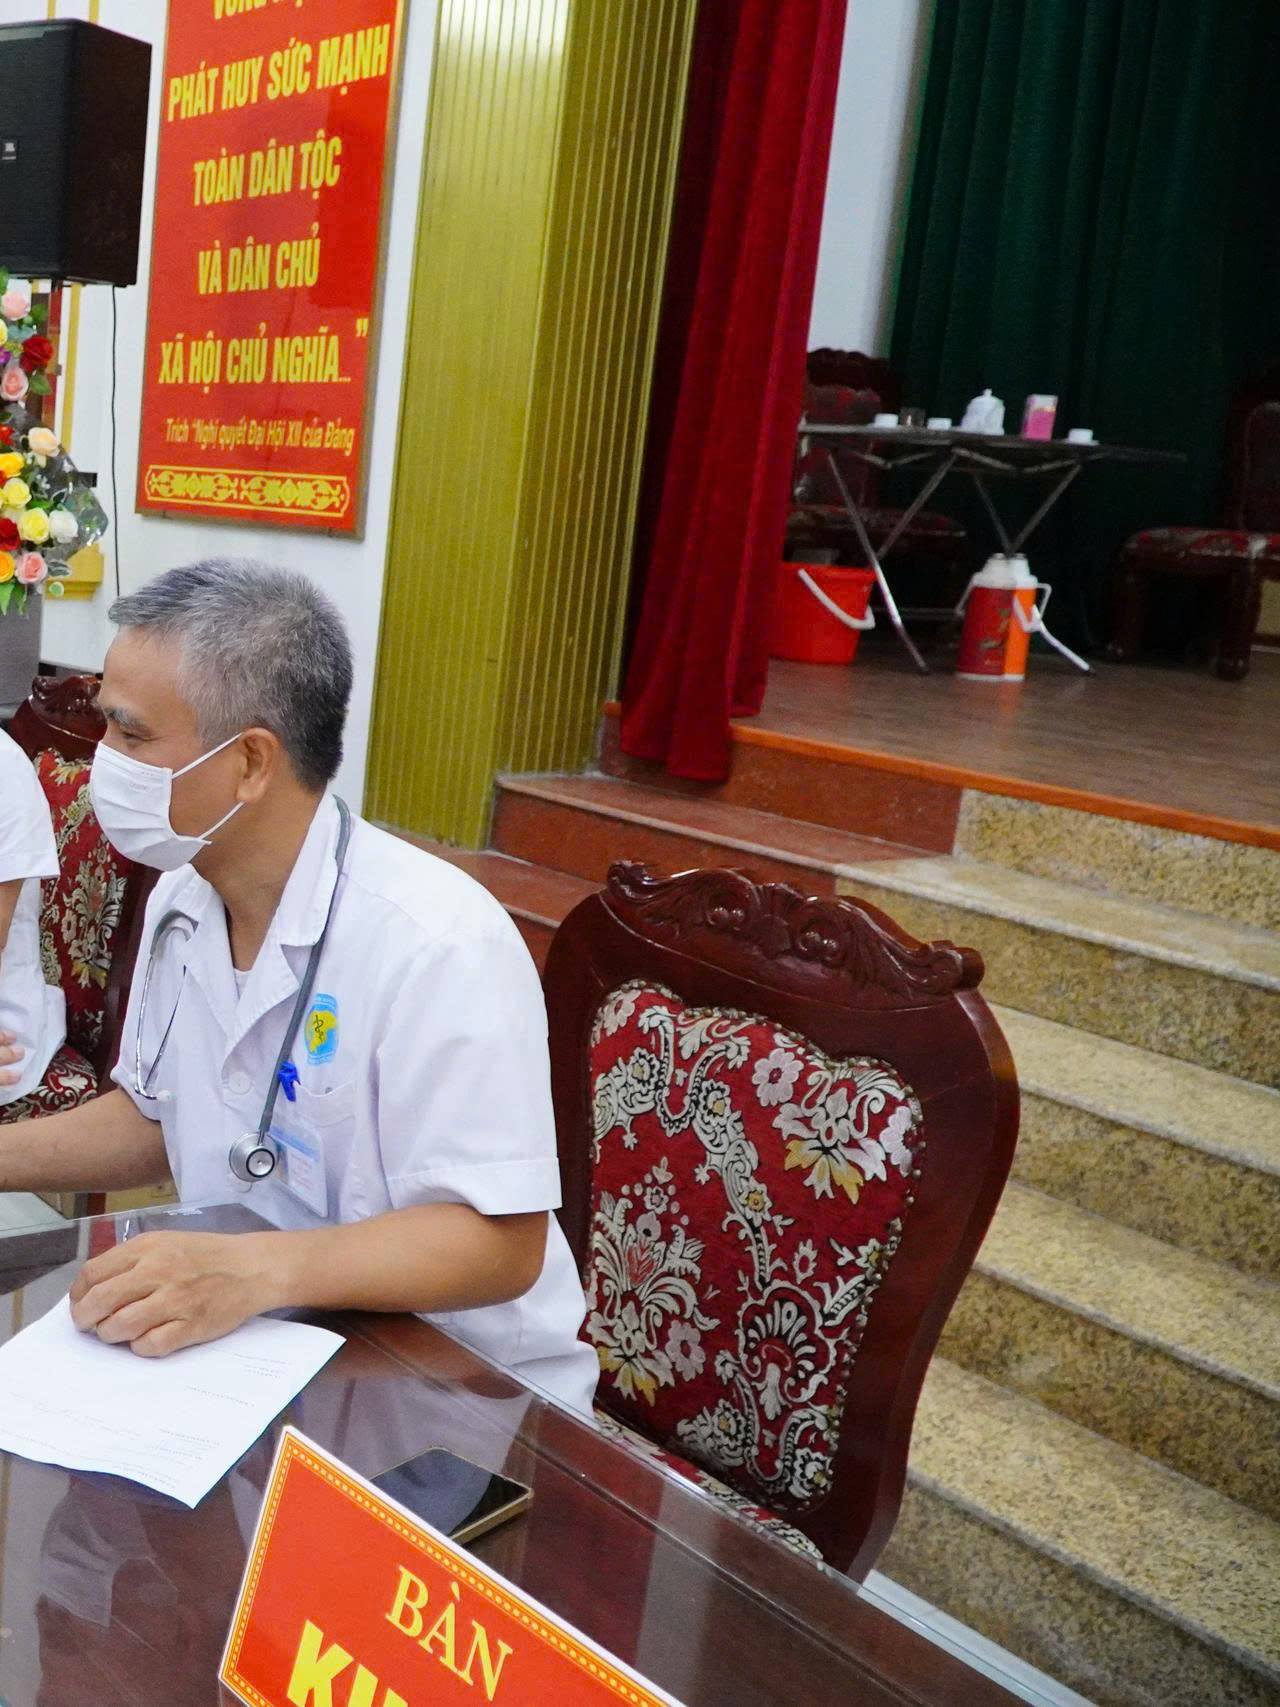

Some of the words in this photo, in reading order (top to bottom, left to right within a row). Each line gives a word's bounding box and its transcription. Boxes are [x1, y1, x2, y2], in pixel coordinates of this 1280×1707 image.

[168, 60, 218, 122] PHÁT
[222, 56, 264, 111] HUY
[267, 37, 312, 100] SỨC
[316, 24, 390, 96] MẠNH
[193, 148, 245, 207] TOÀN
[248, 138, 294, 198] DÂN
[300, 128, 342, 200] TỘC
[198, 240, 222, 295] VÀ
[227, 236, 271, 292] DÂN
[276, 222, 320, 289] CHỦ
[158, 333, 184, 384] XÃ
[188, 331, 222, 394] HỘI
[226, 322, 268, 384] CHỦ
[166, 417, 189, 443] Trích
[324, 417, 356, 457] Đảng
[385, 1564, 513, 1703] BÀN
